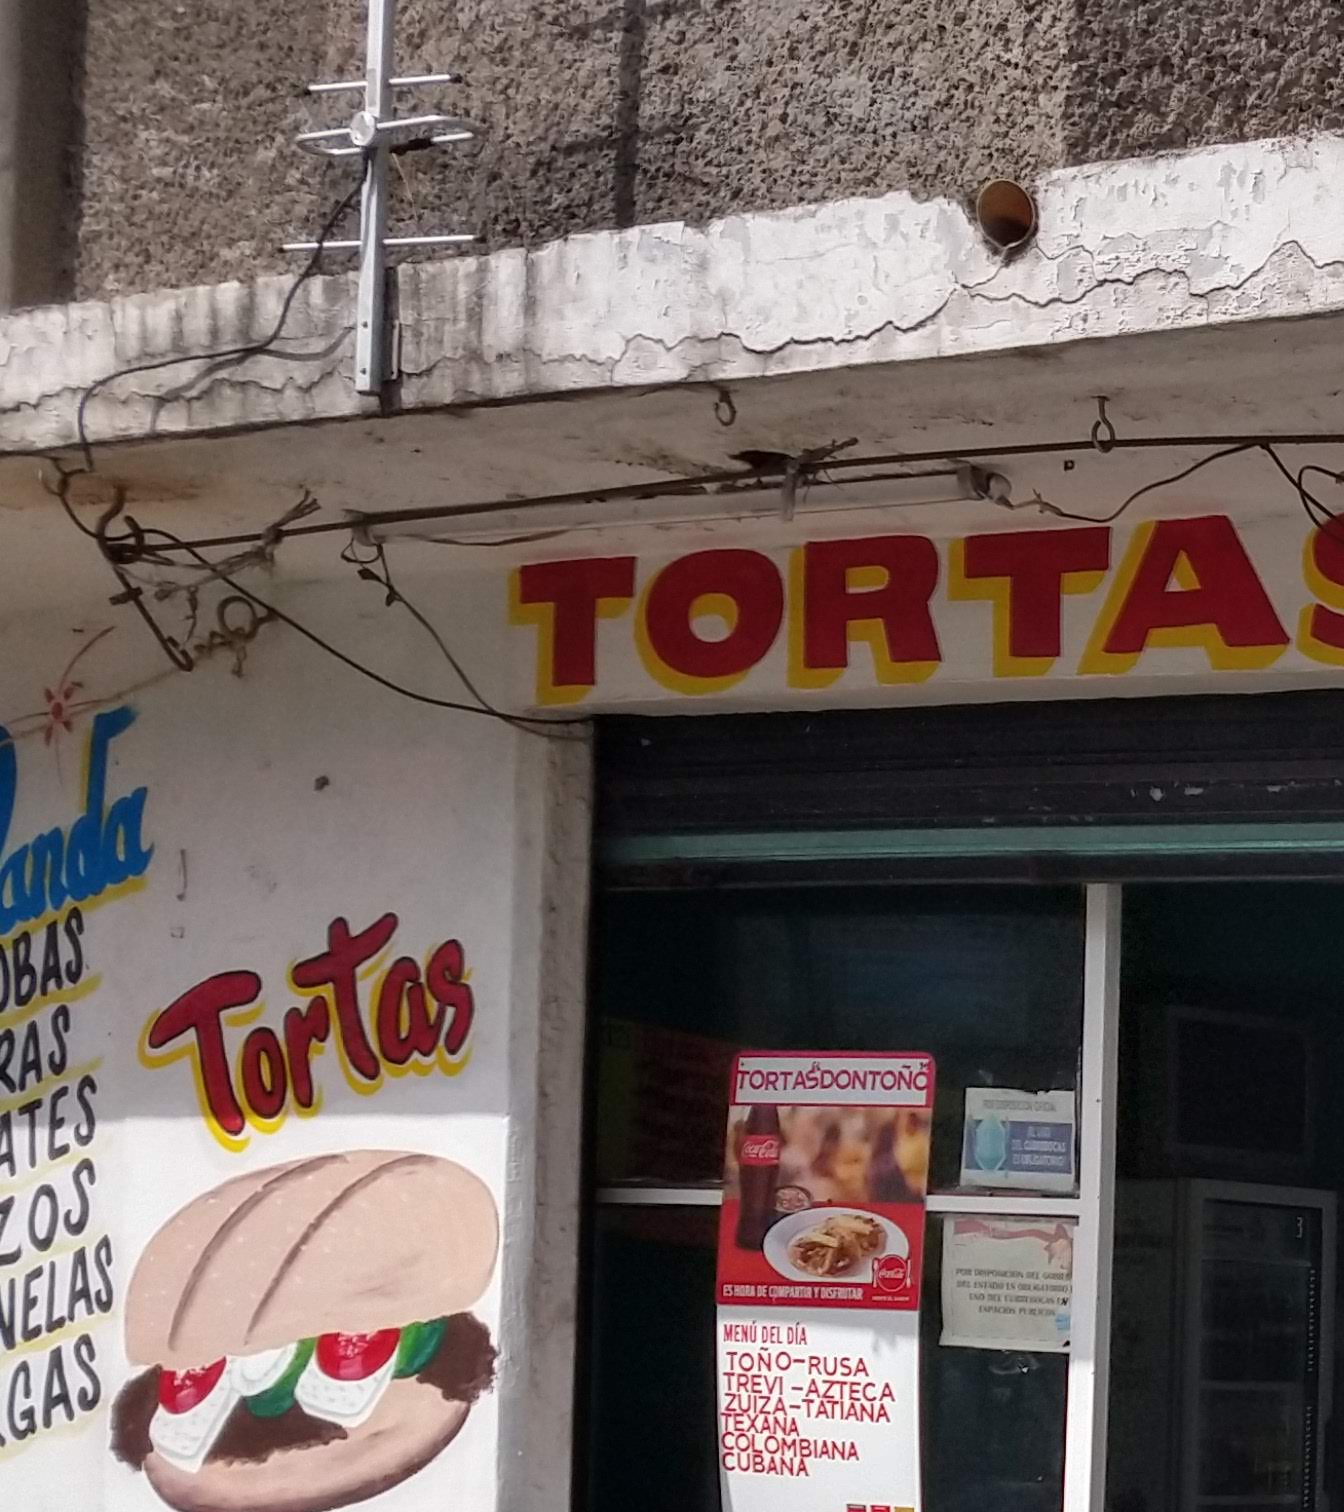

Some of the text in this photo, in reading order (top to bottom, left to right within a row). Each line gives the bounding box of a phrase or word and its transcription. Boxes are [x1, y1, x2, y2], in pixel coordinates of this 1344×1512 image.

[0, 702, 155, 936] anda
[140, 912, 474, 1150] Tortas
[723, 1321, 808, 1345] MENÚ DEL DÍA
[723, 1373, 783, 1395] TREVI
[720, 1412, 800, 1437] TEXANA
[721, 1432, 860, 1461] COLOMBIANA
[721, 1452, 810, 1477] CUBANA
